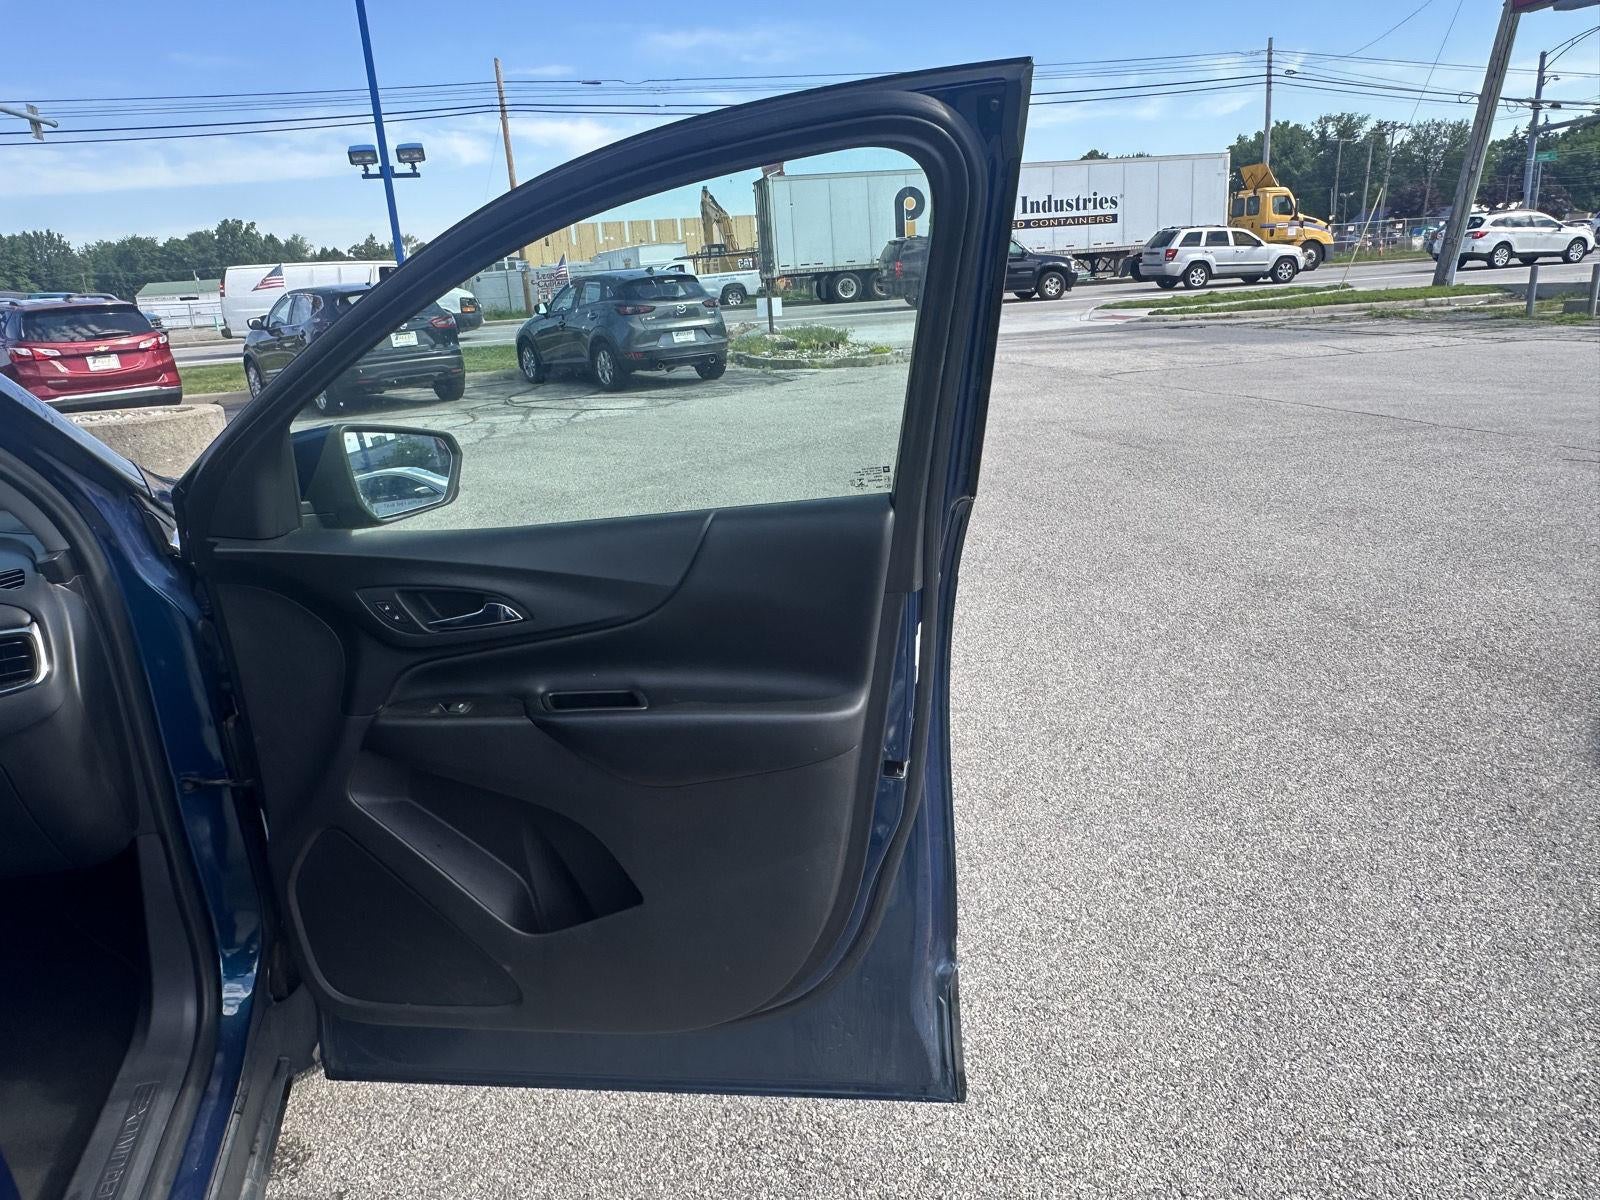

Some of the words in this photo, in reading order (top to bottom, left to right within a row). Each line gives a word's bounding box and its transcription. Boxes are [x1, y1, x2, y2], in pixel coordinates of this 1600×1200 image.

[1020, 191, 1119, 214] Industries
[1030, 215, 1113, 228] CONTAINERS
[737, 257, 754, 269] CAT
